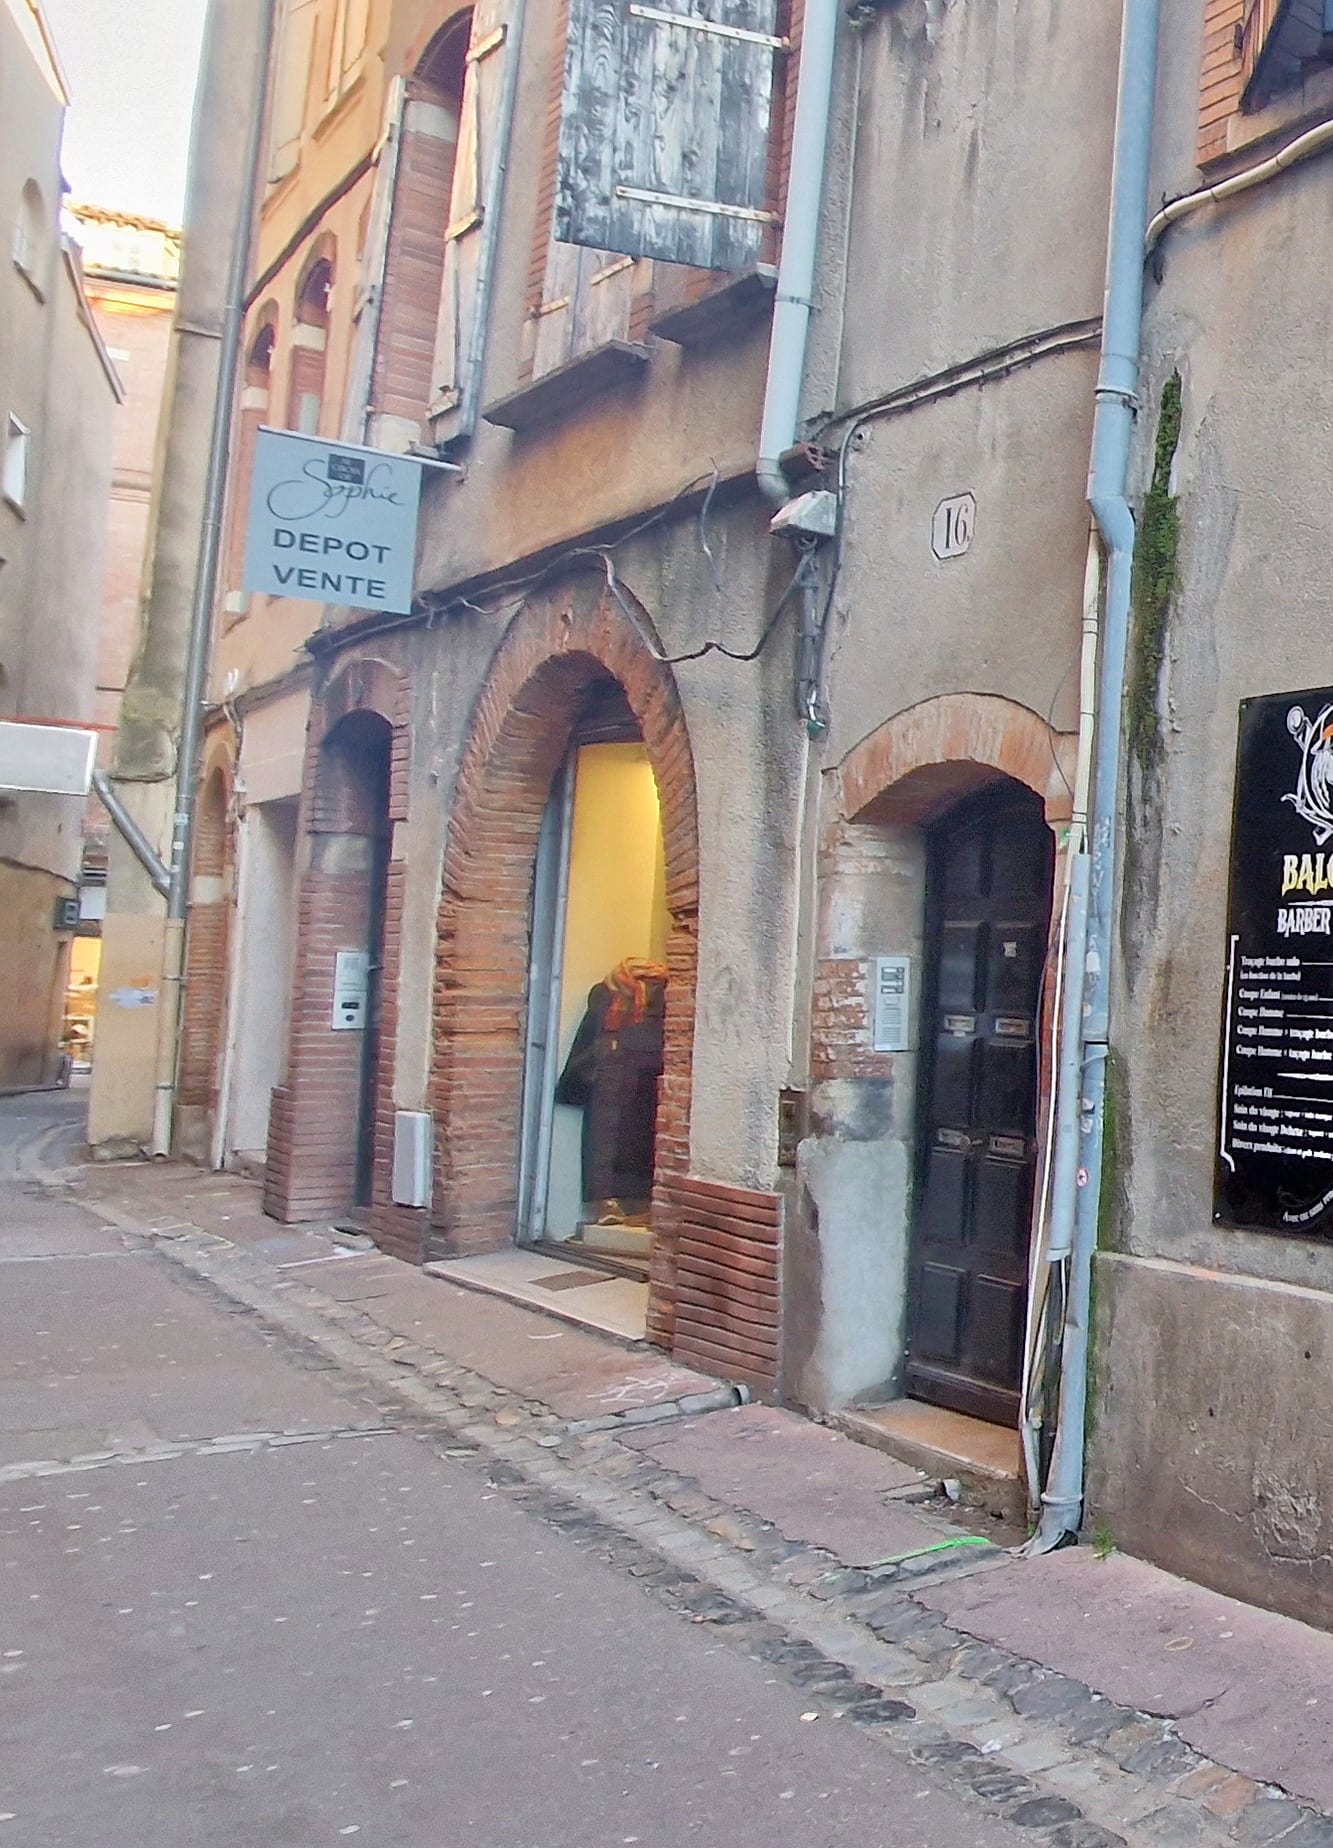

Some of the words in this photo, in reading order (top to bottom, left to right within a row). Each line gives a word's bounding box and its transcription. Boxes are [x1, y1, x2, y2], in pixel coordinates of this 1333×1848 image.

[267, 459, 407, 521] Sophie
[273, 527, 392, 564] DEPOT
[273, 564, 386, 599] VENTE
[1277, 907, 1331, 937] BARBER
